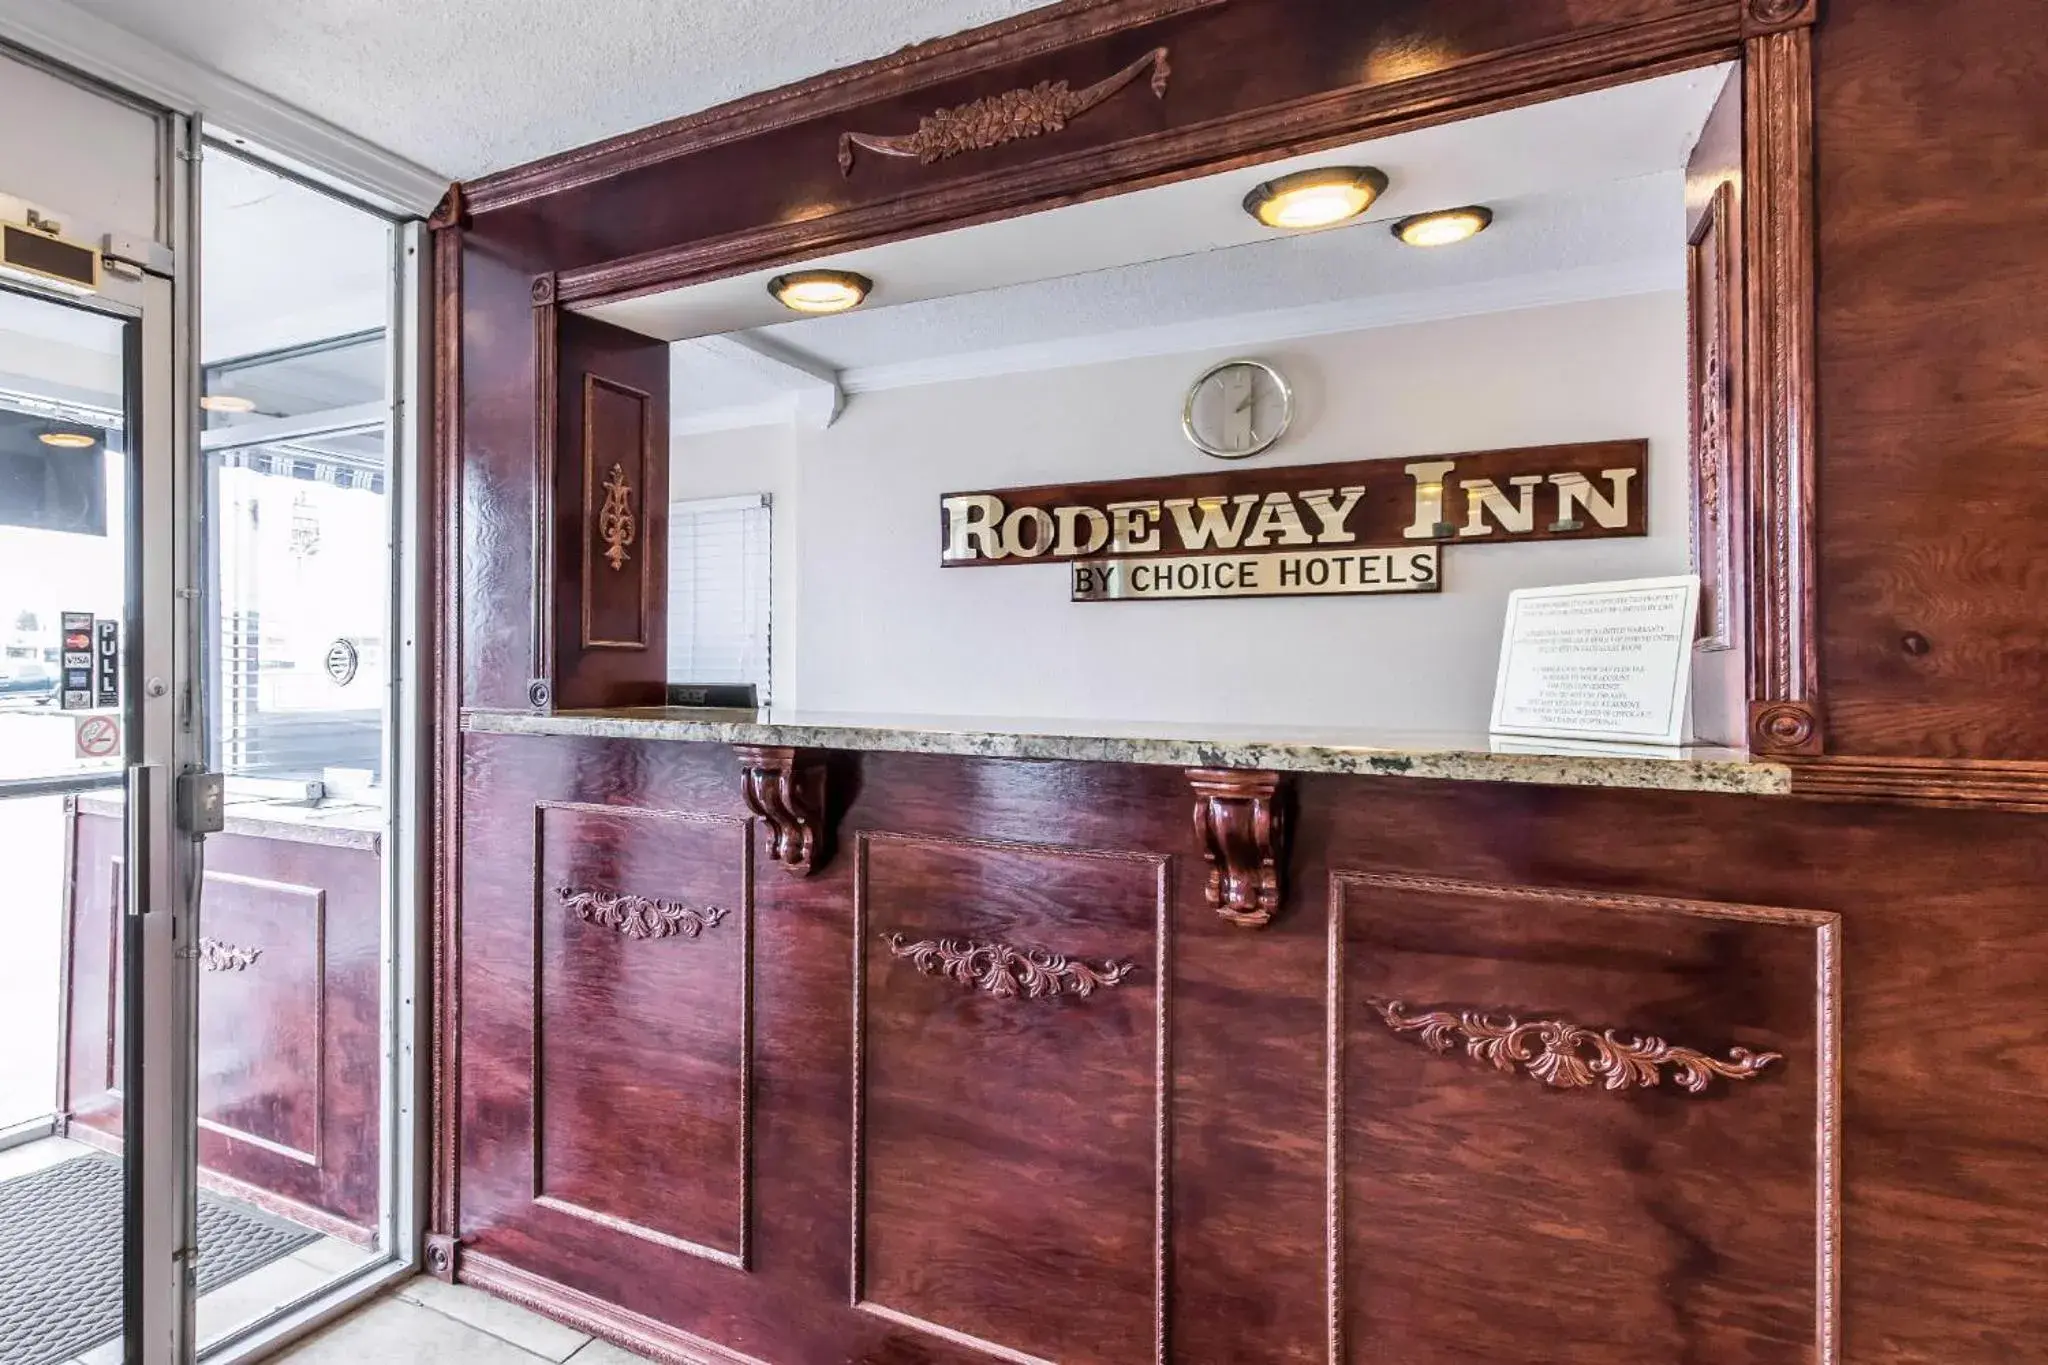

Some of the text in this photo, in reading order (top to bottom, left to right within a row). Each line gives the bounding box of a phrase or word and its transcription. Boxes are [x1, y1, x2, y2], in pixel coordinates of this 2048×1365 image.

[943, 461, 1637, 559] RODEWAY INN
[1075, 553, 1435, 593] BY CHOICE HOTELS
[66, 656, 90, 665] VISA
[102, 623, 115, 691] PULL
